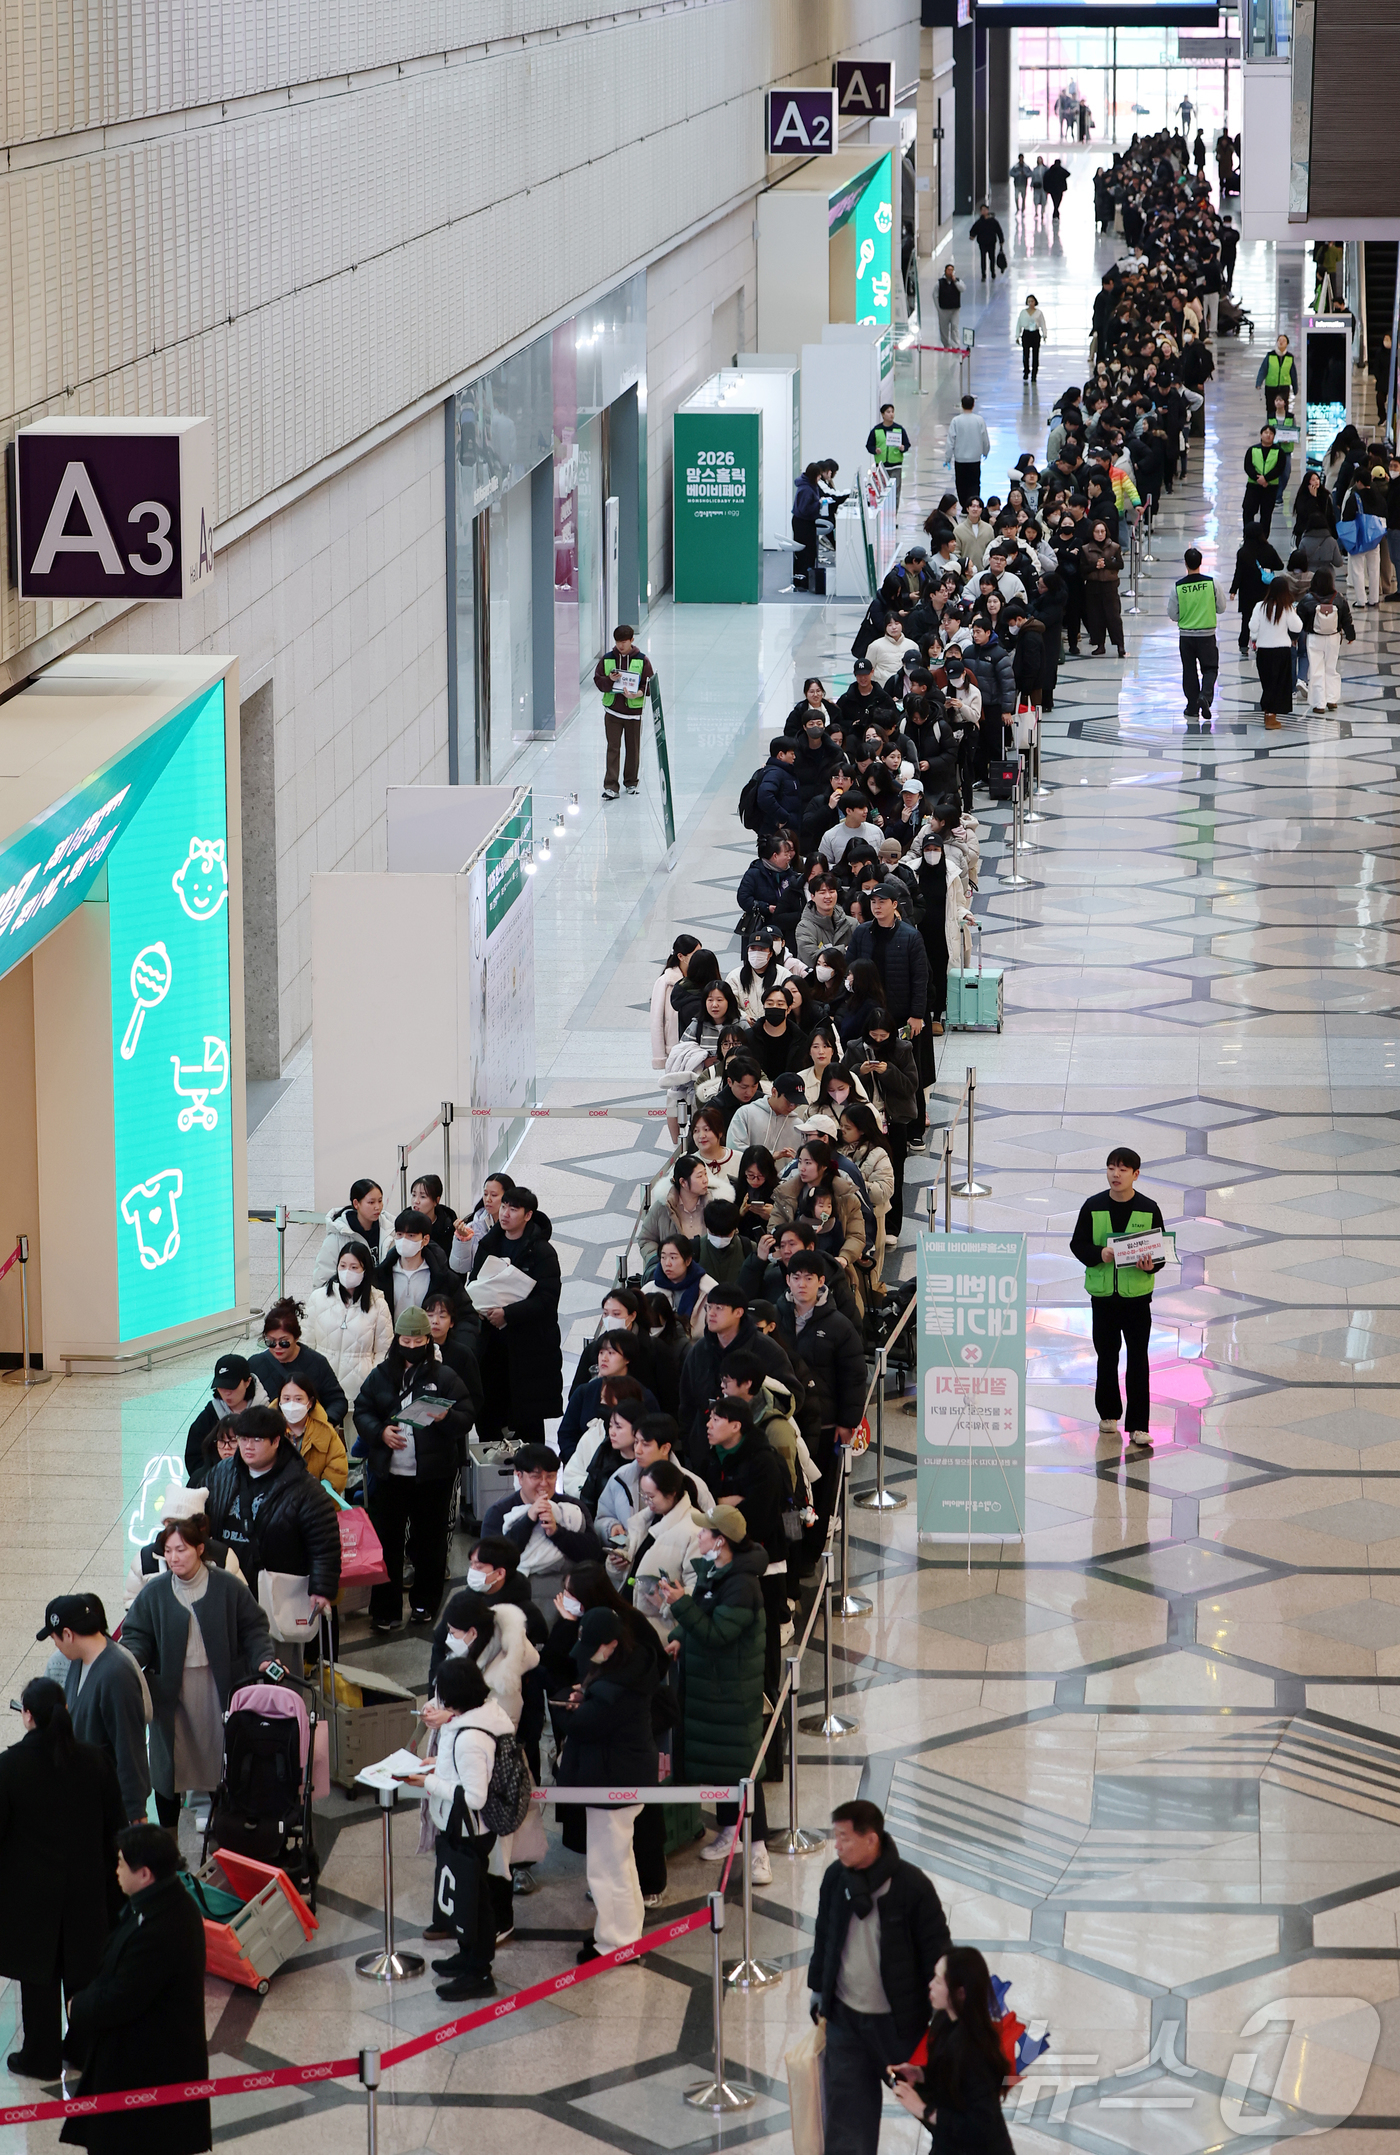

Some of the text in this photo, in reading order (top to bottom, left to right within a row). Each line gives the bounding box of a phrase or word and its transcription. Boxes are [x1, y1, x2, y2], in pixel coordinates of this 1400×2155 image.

[840, 69, 887, 110] A1
[773, 102, 830, 146] A2
[686, 467, 746, 483] 맘스홀릭
[697, 451, 735, 465] 2026
[686, 484, 746, 497] 베이비페어
[30, 461, 175, 576] A3
[189, 506, 214, 585] Hall A3
[1182, 583, 1207, 593] STAFF
[471, 1108, 668, 1117] coex coex coex coex
[530, 1788, 730, 1801] ex coex coex
[437, 1864, 456, 1917] C
[435, 1918, 691, 2043] coex coex coex coex coex
[4, 2063, 335, 2122] coex coex coex coex coex coex
